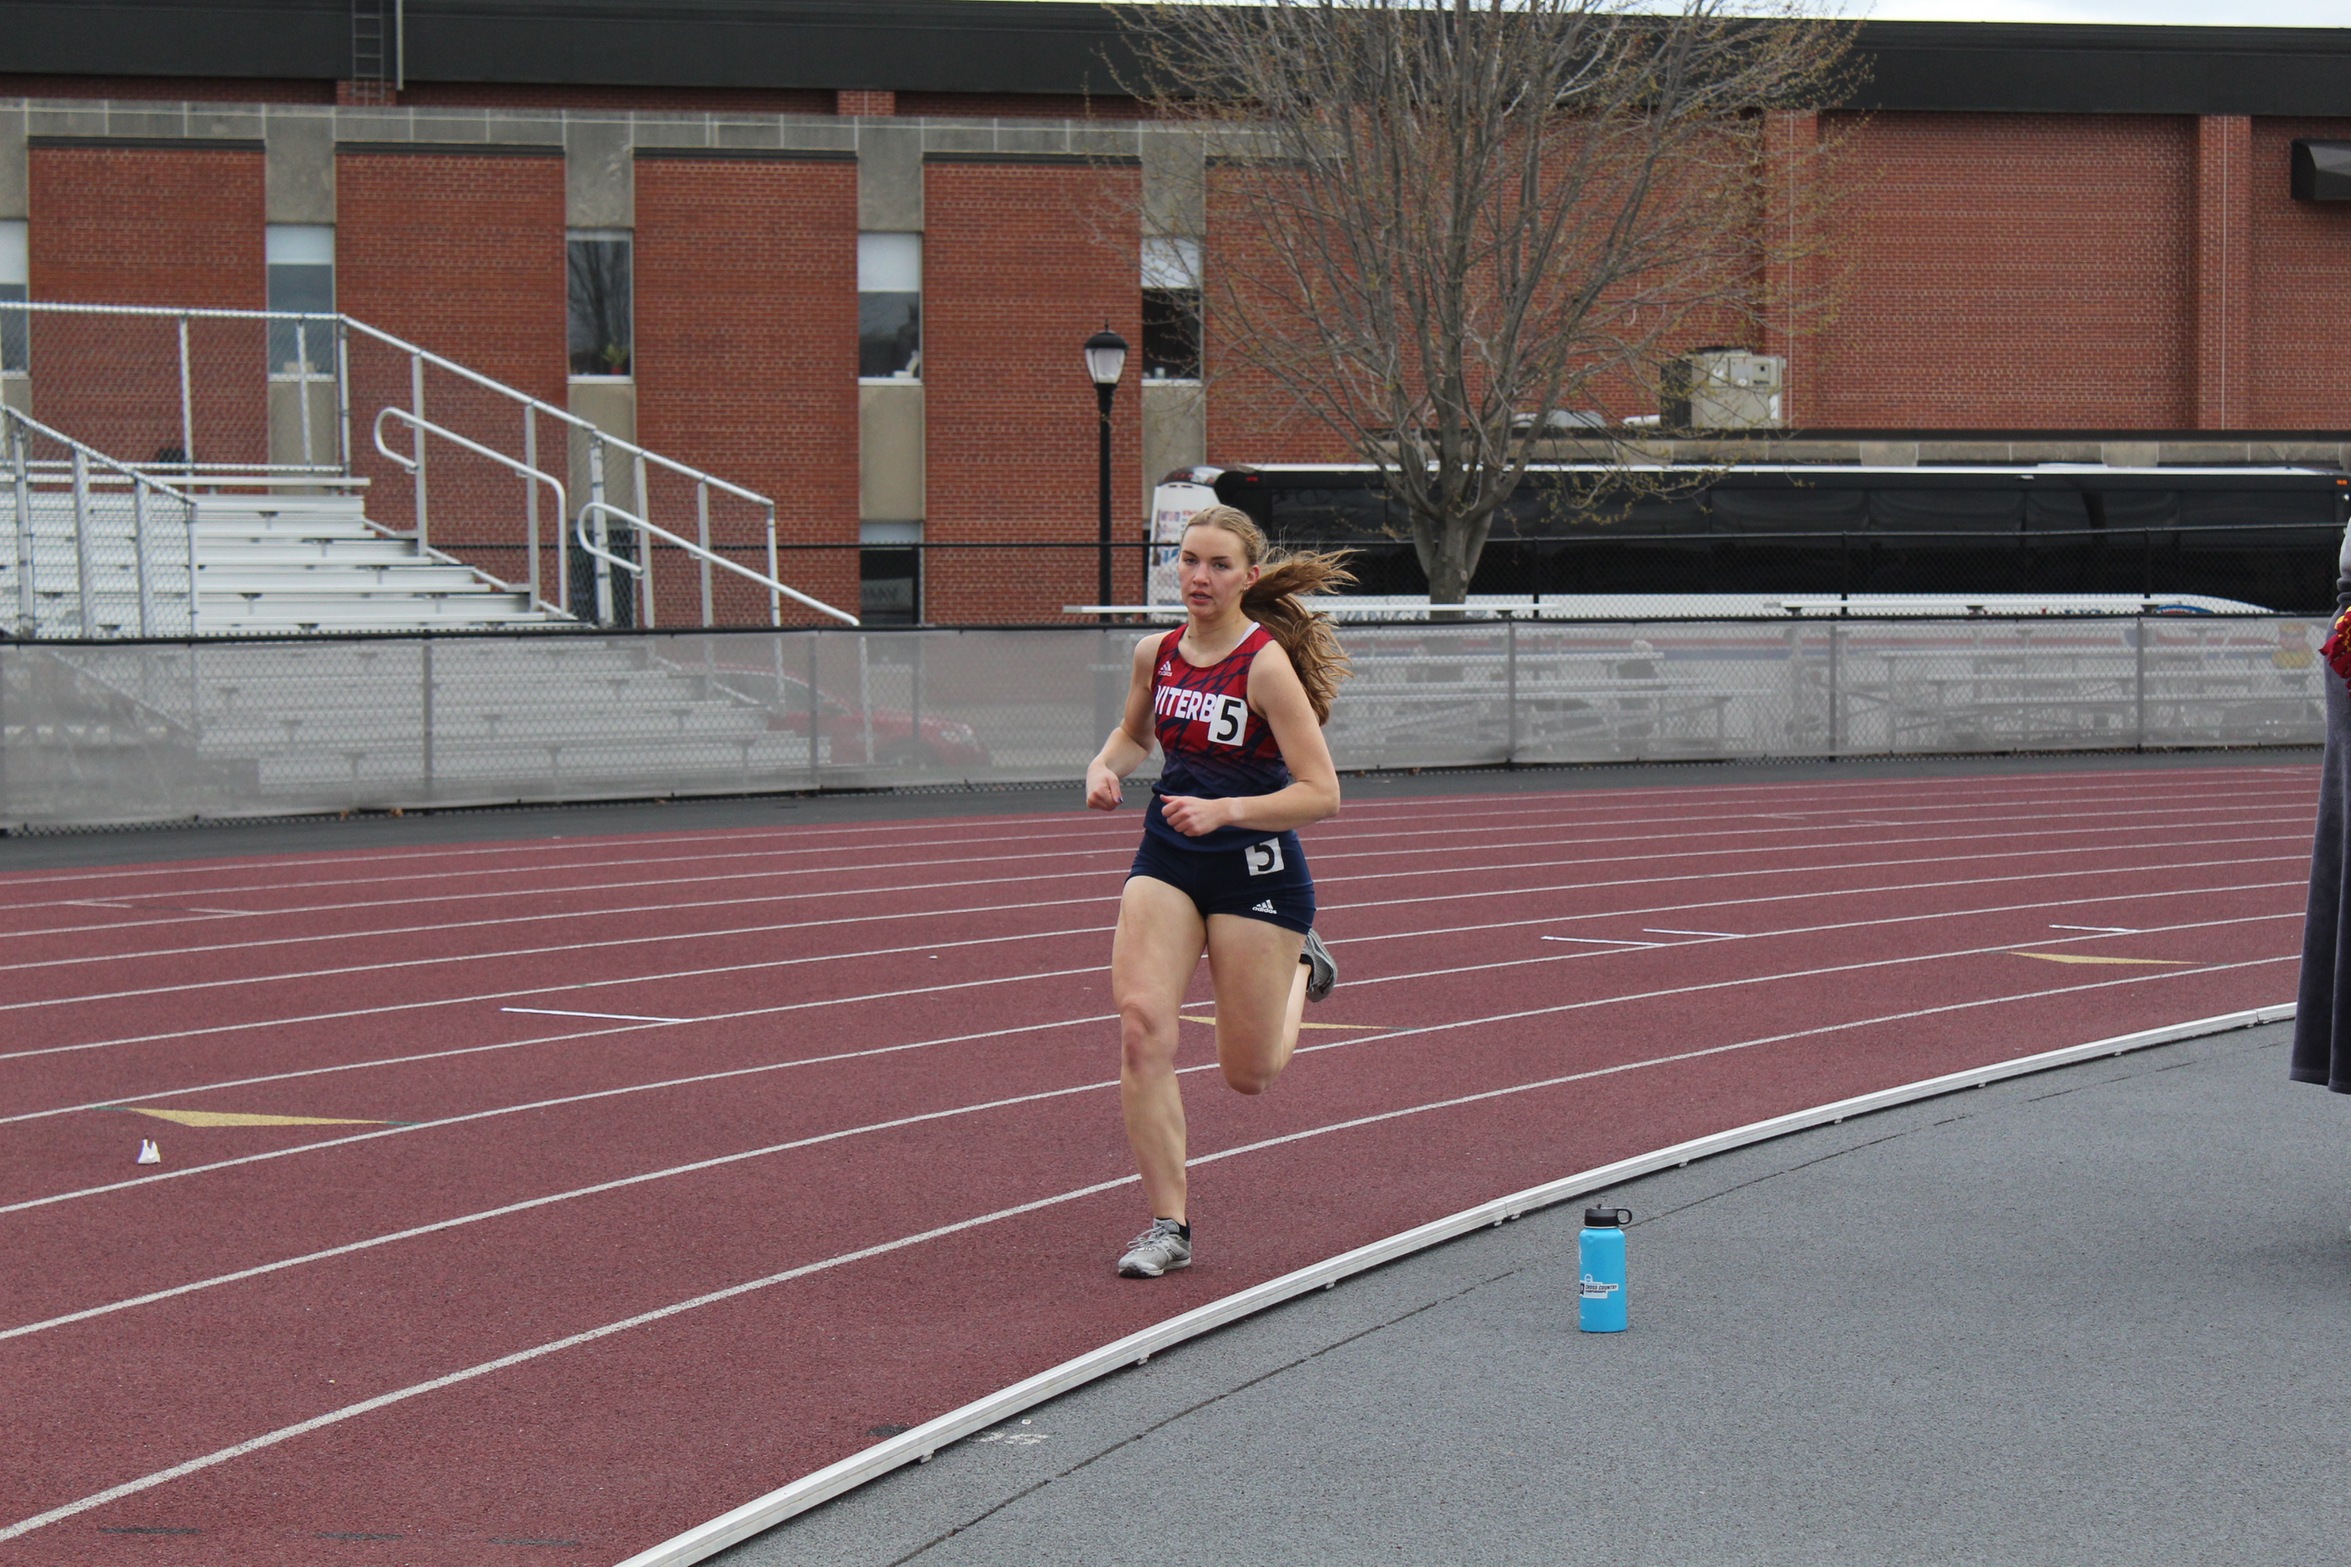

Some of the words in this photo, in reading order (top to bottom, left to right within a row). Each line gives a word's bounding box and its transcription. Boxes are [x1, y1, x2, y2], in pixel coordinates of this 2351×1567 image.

[1155, 685, 1217, 723] VITERB
[1216, 699, 1242, 742] 5
[1252, 906, 1278, 915] adidas
